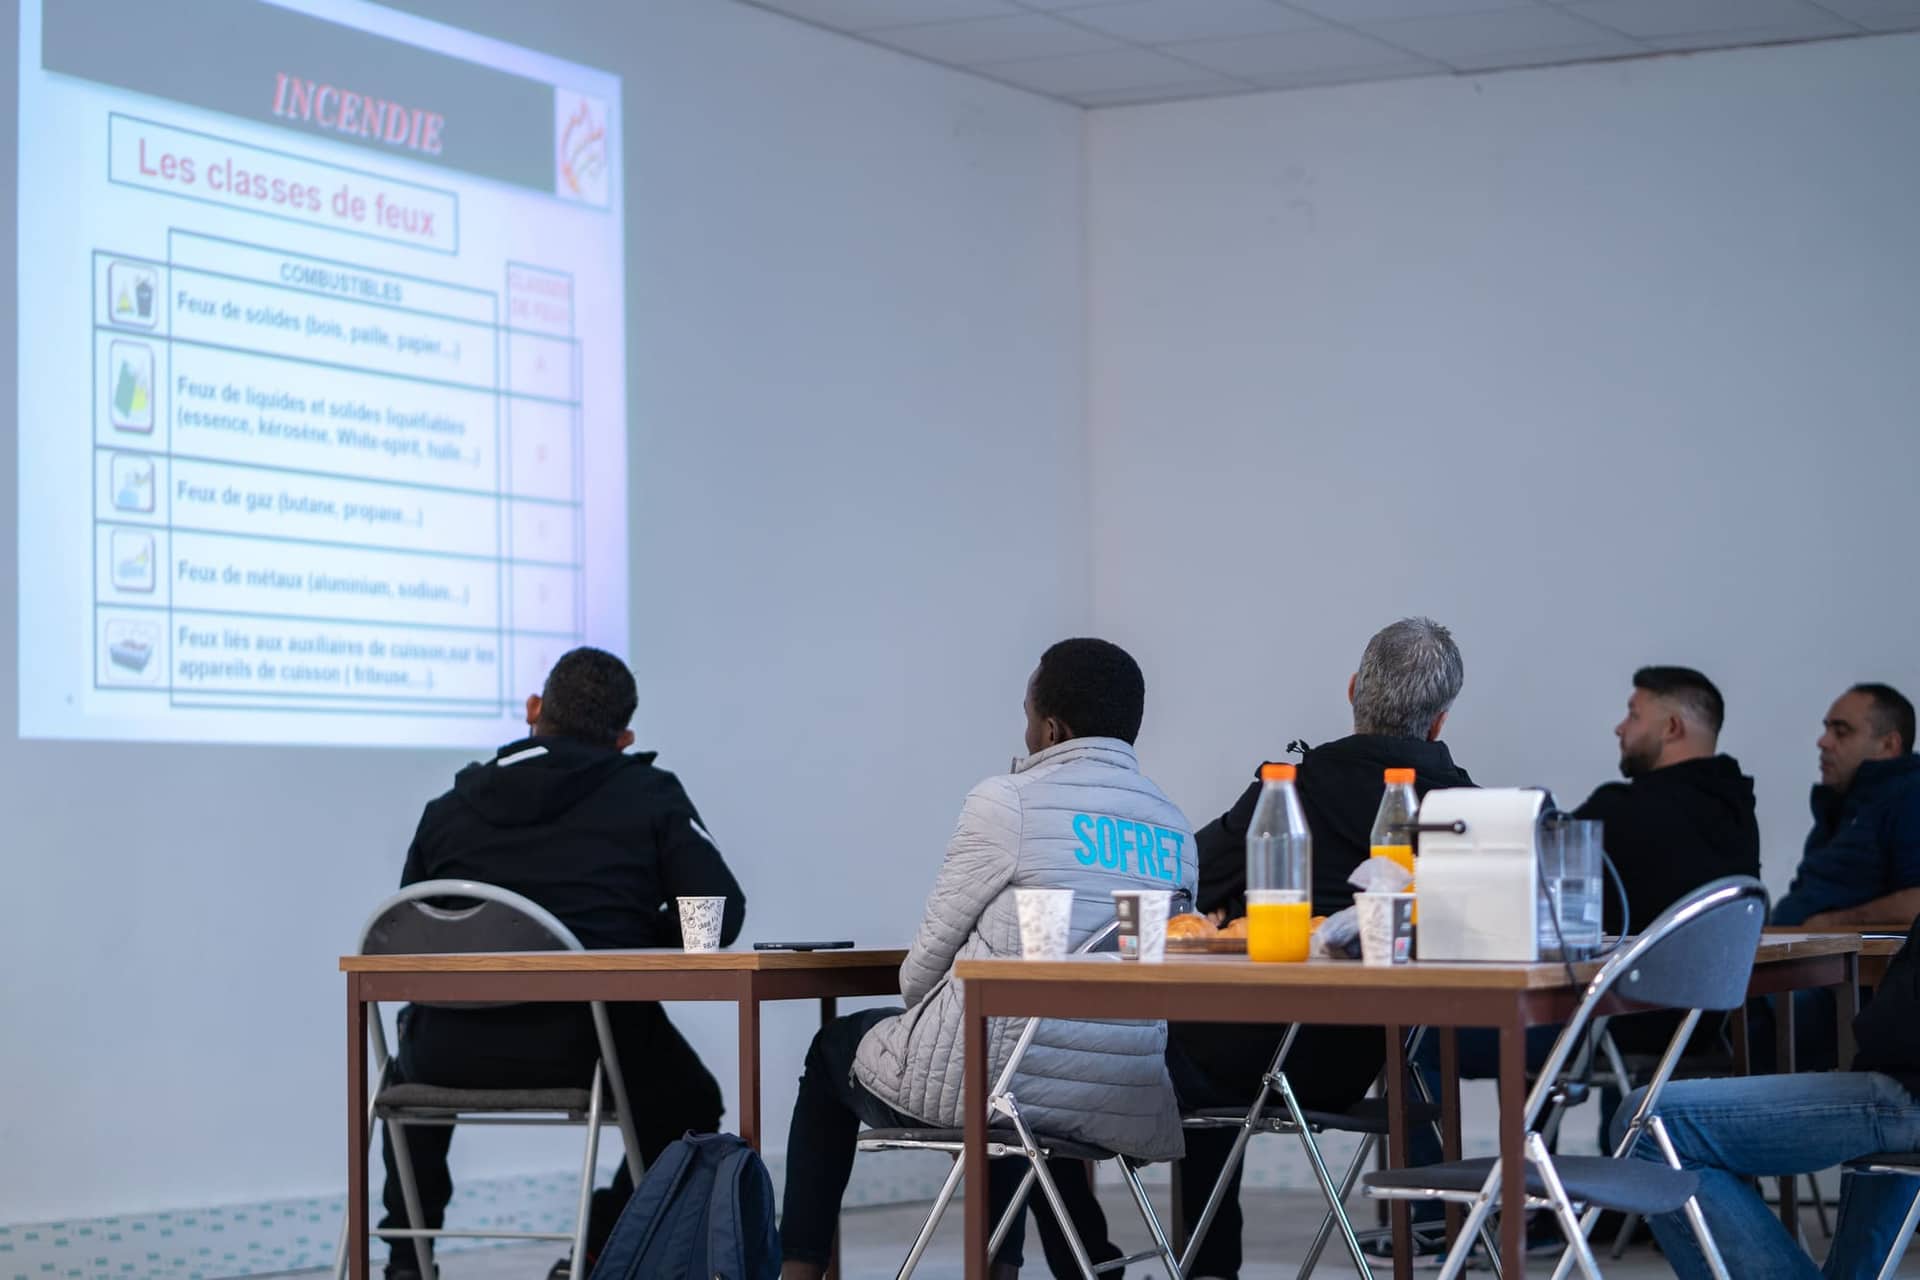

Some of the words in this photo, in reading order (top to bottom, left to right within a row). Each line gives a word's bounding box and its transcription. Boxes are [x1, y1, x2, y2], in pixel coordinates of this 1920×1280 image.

[272, 73, 444, 155] INCENDIE
[138, 138, 196, 184] Les
[207, 159, 321, 213] classes
[332, 184, 367, 221] de
[375, 193, 435, 236] feux
[280, 262, 402, 302] COMBUSTIBLES
[177, 290, 217, 315] Feux
[221, 298, 242, 320] de
[245, 303, 301, 331] solides
[177, 376, 217, 399] Feux
[221, 383, 241, 404] de
[245, 386, 306, 413] liquides
[310, 397, 325, 413] et
[329, 400, 380, 424] solides
[177, 480, 217, 502] Feux
[221, 485, 241, 506] de
[246, 491, 273, 513] gaz
[177, 559, 217, 582] Feux
[222, 565, 242, 584] de
[246, 566, 302, 589] métaux
[178, 626, 217, 648] Feux
[223, 629, 250, 650] liés
[255, 634, 282, 651] aux
[287, 634, 364, 657] auxiliaires
[368, 638, 386, 658] de
[178, 657, 252, 680] appareils
[256, 660, 277, 681] de
[281, 662, 340, 682] cuisson
[1072, 813, 1184, 885] SOFRET
